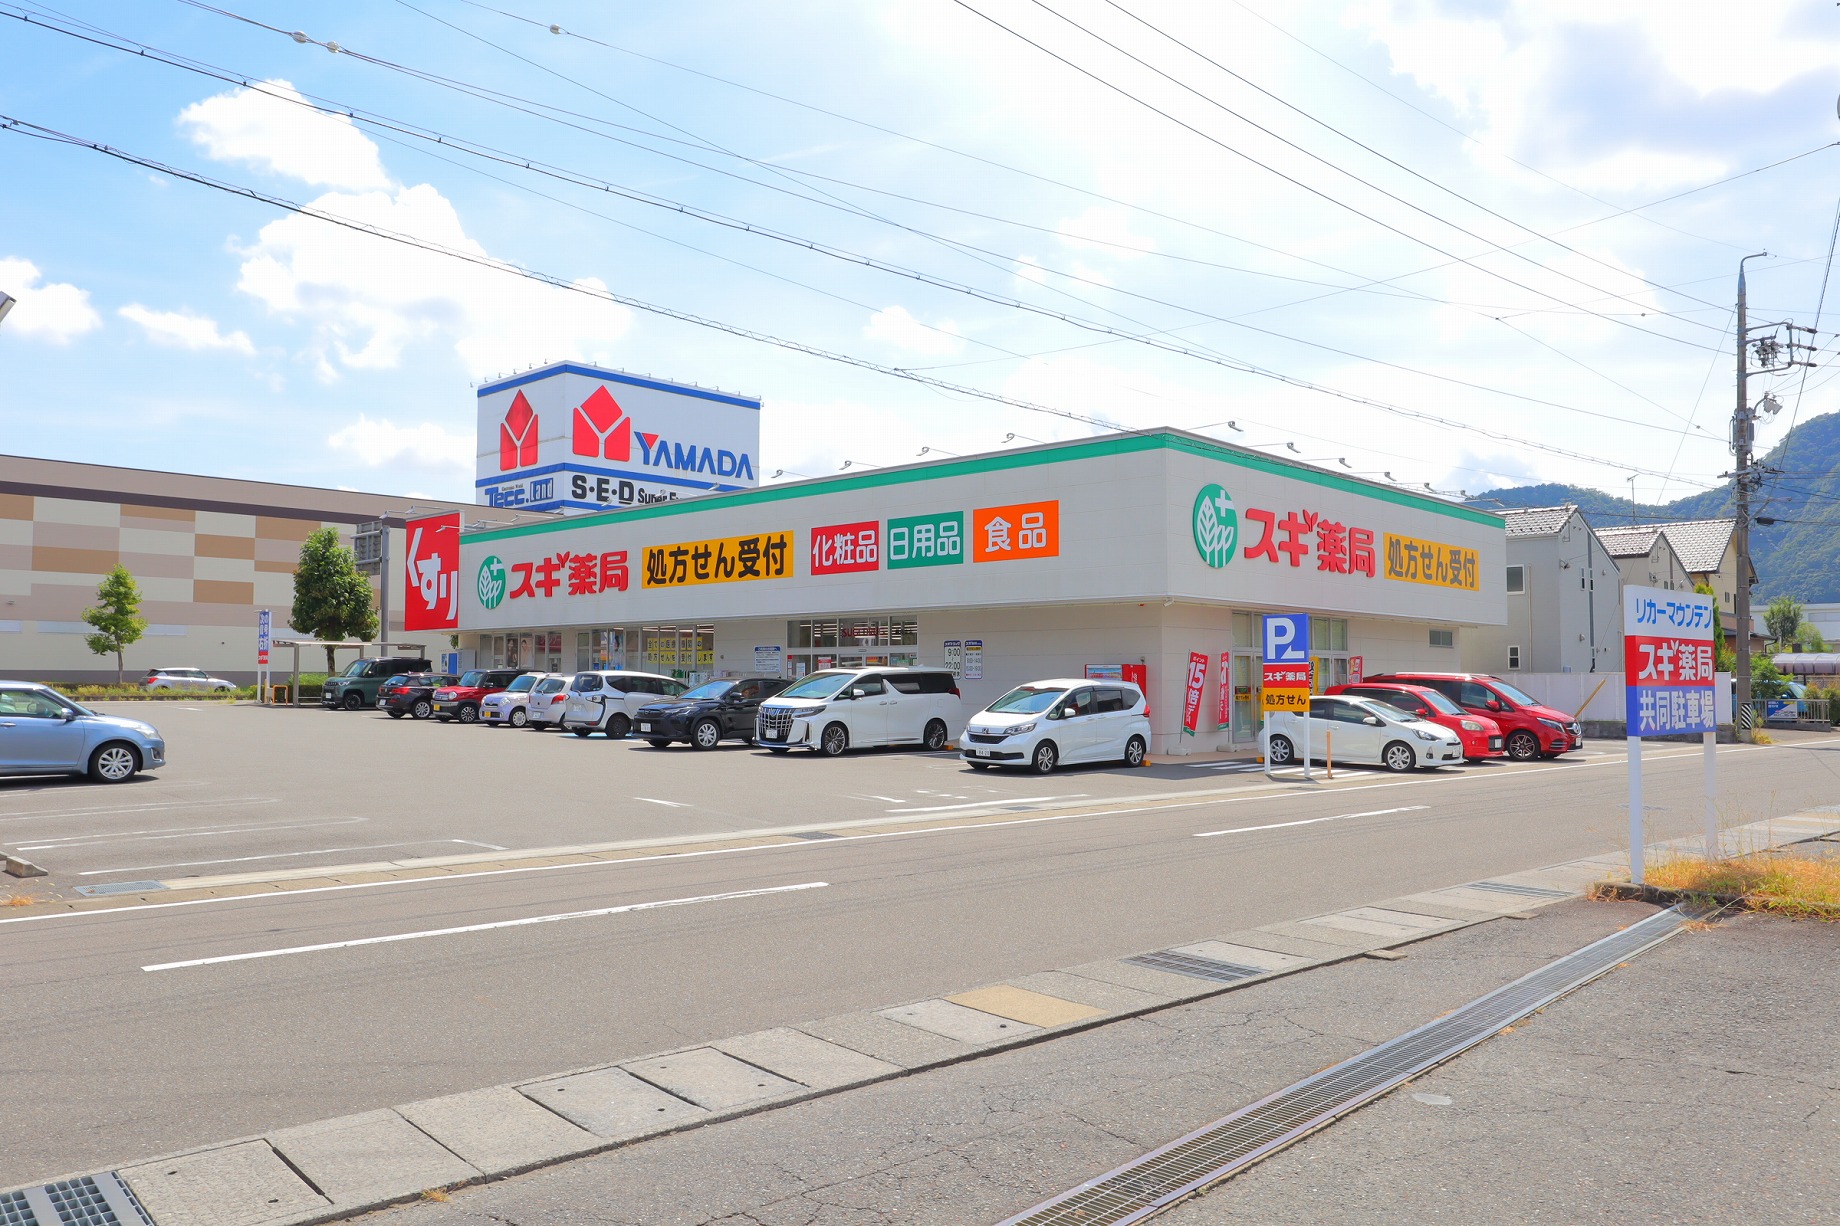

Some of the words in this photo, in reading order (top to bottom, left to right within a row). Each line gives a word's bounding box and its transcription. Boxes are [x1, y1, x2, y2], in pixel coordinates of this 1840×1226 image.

[633, 431, 754, 480] YAMADA
[812, 529, 878, 566] 化粧品
[889, 519, 962, 562] 日用品
[985, 511, 1048, 553] 食品
[1244, 508, 1376, 578] スギ薬局
[406, 527, 458, 620] くすり
[509, 550, 628, 598] スギ薬局
[646, 533, 788, 586] 処方せん受付
[1387, 535, 1477, 588] 処方せん受付
[1636, 598, 1713, 629] リカーマウンテン
[1266, 617, 1296, 660] P
[1264, 670, 1307, 682] スギ薬局
[1638, 640, 1714, 681] スギ薬局
[1265, 694, 1306, 706] 処方せん
[1639, 689, 1715, 731] 共同駐車場
